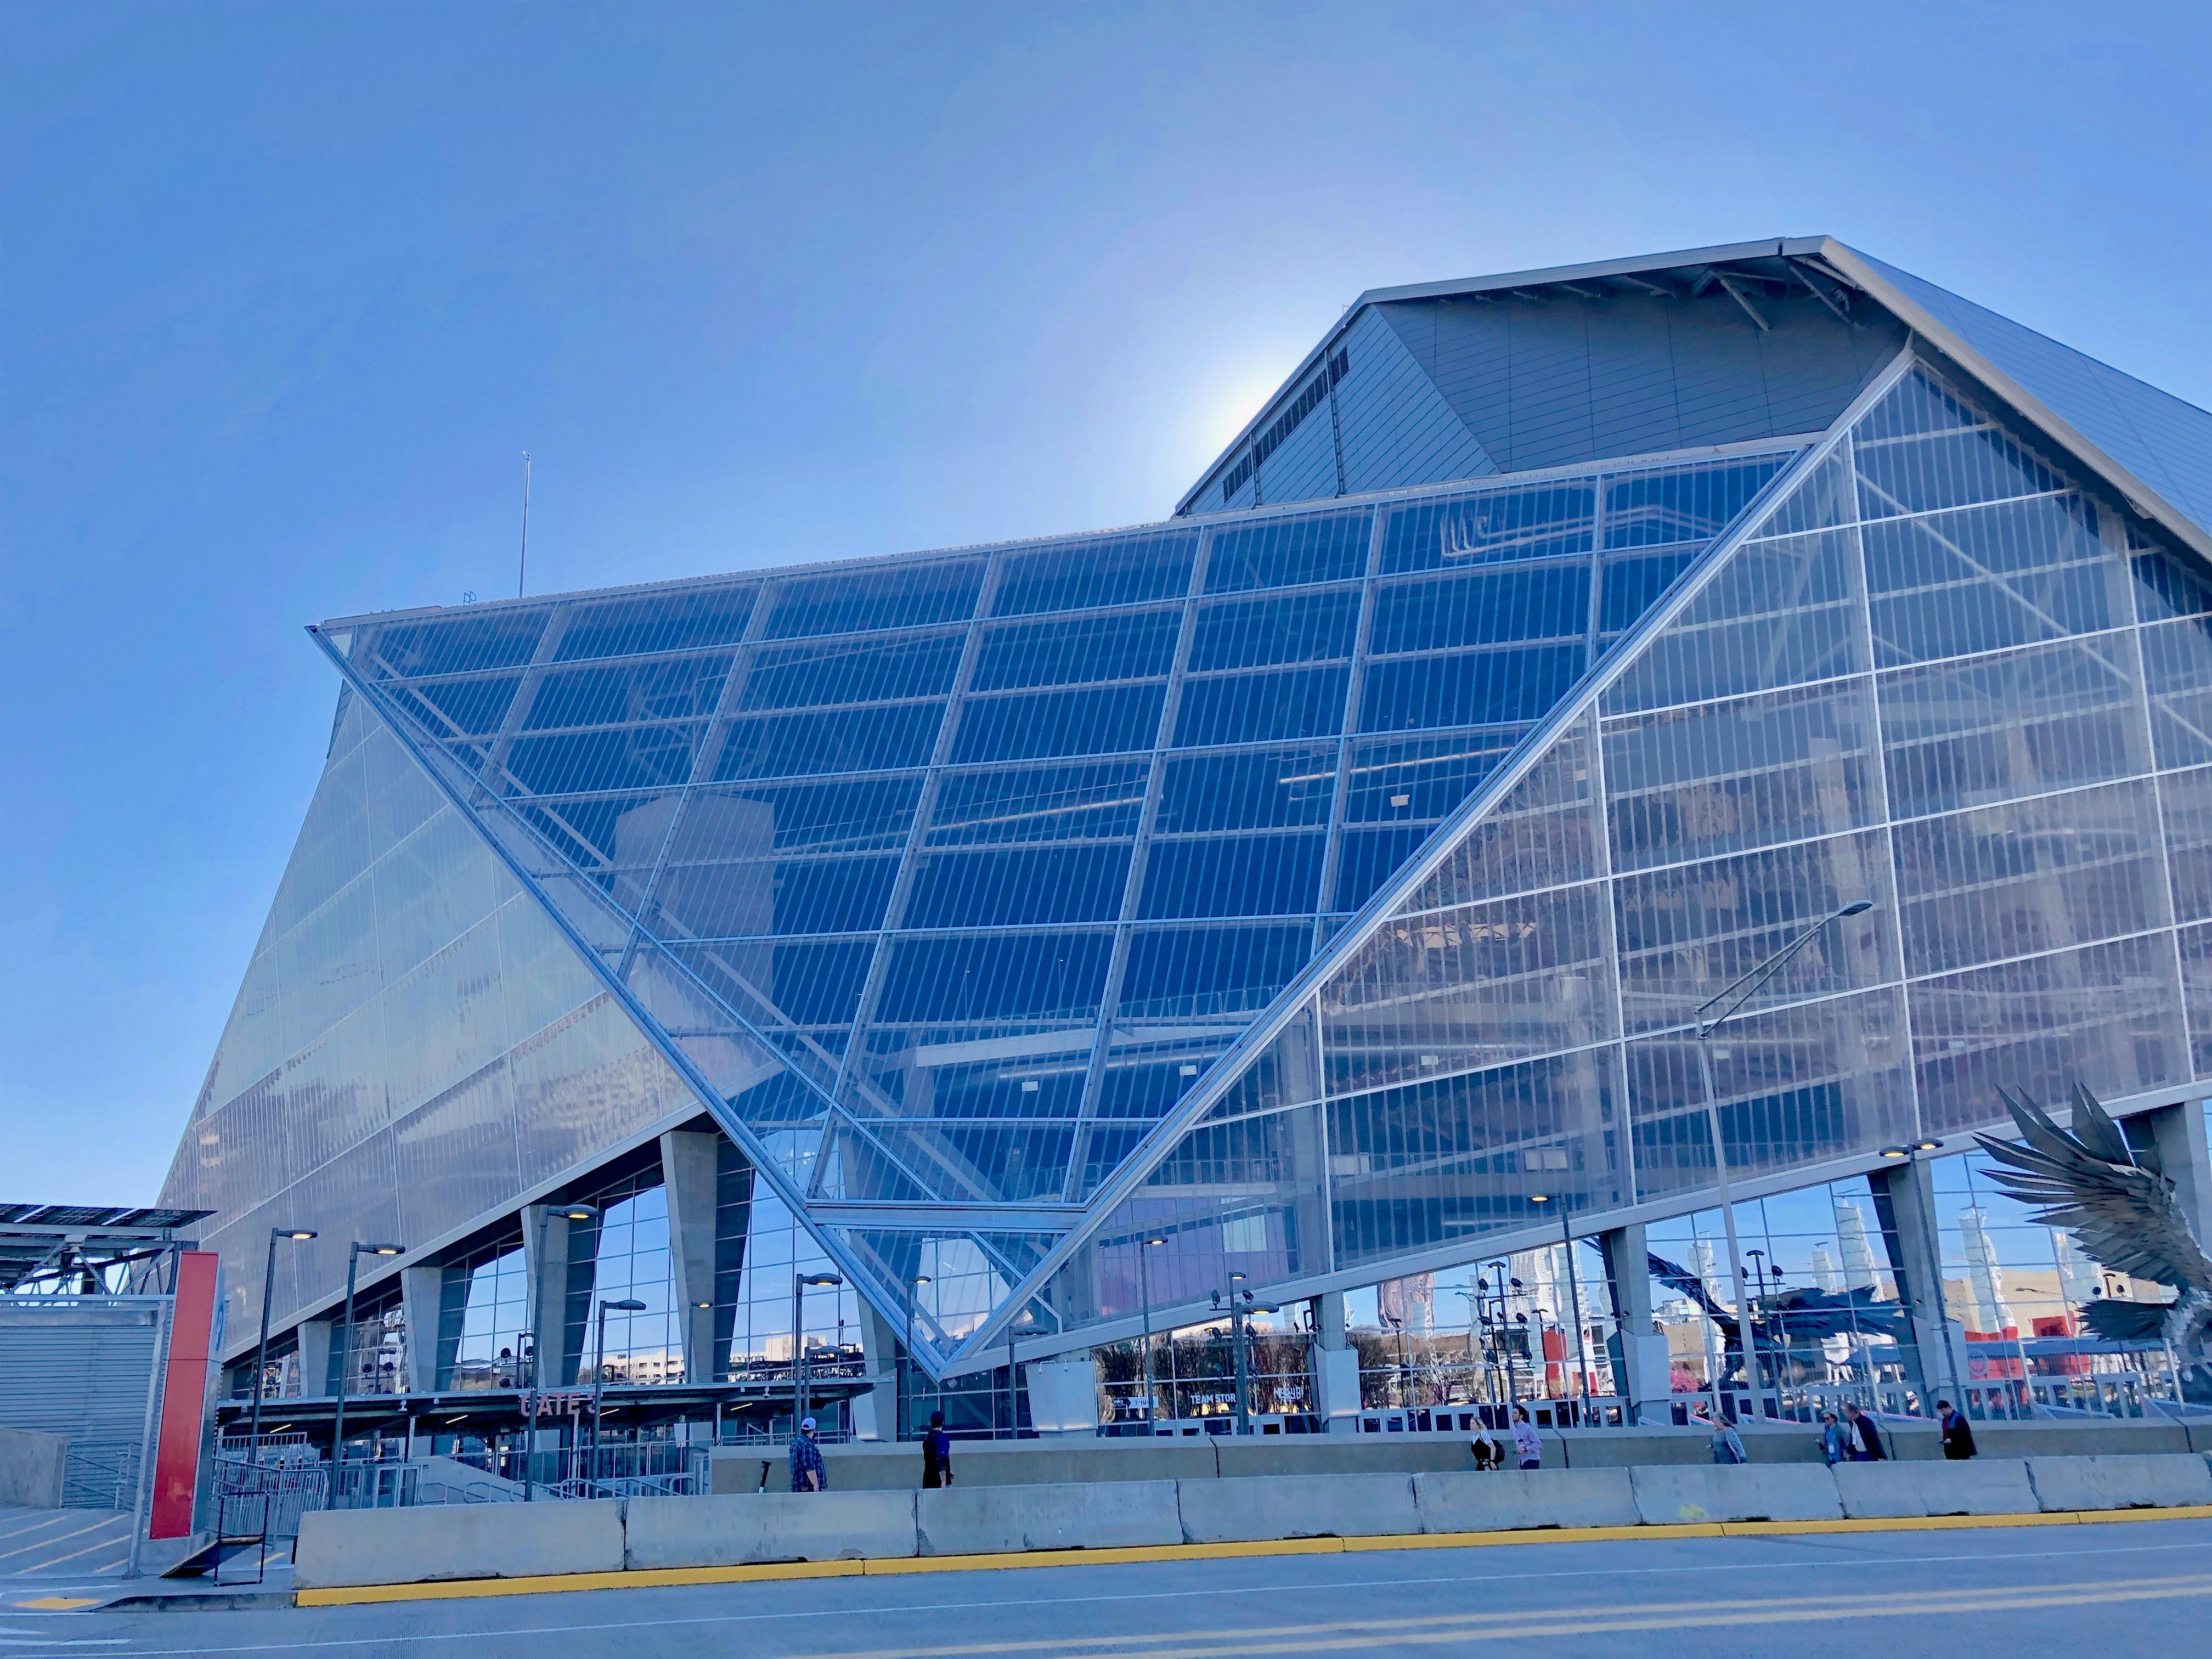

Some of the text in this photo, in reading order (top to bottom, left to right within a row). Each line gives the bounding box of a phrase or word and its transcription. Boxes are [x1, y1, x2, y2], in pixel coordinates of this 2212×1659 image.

[521, 1392, 580, 1417] GATE
[1190, 1393, 1237, 1404] TEAM STOR
